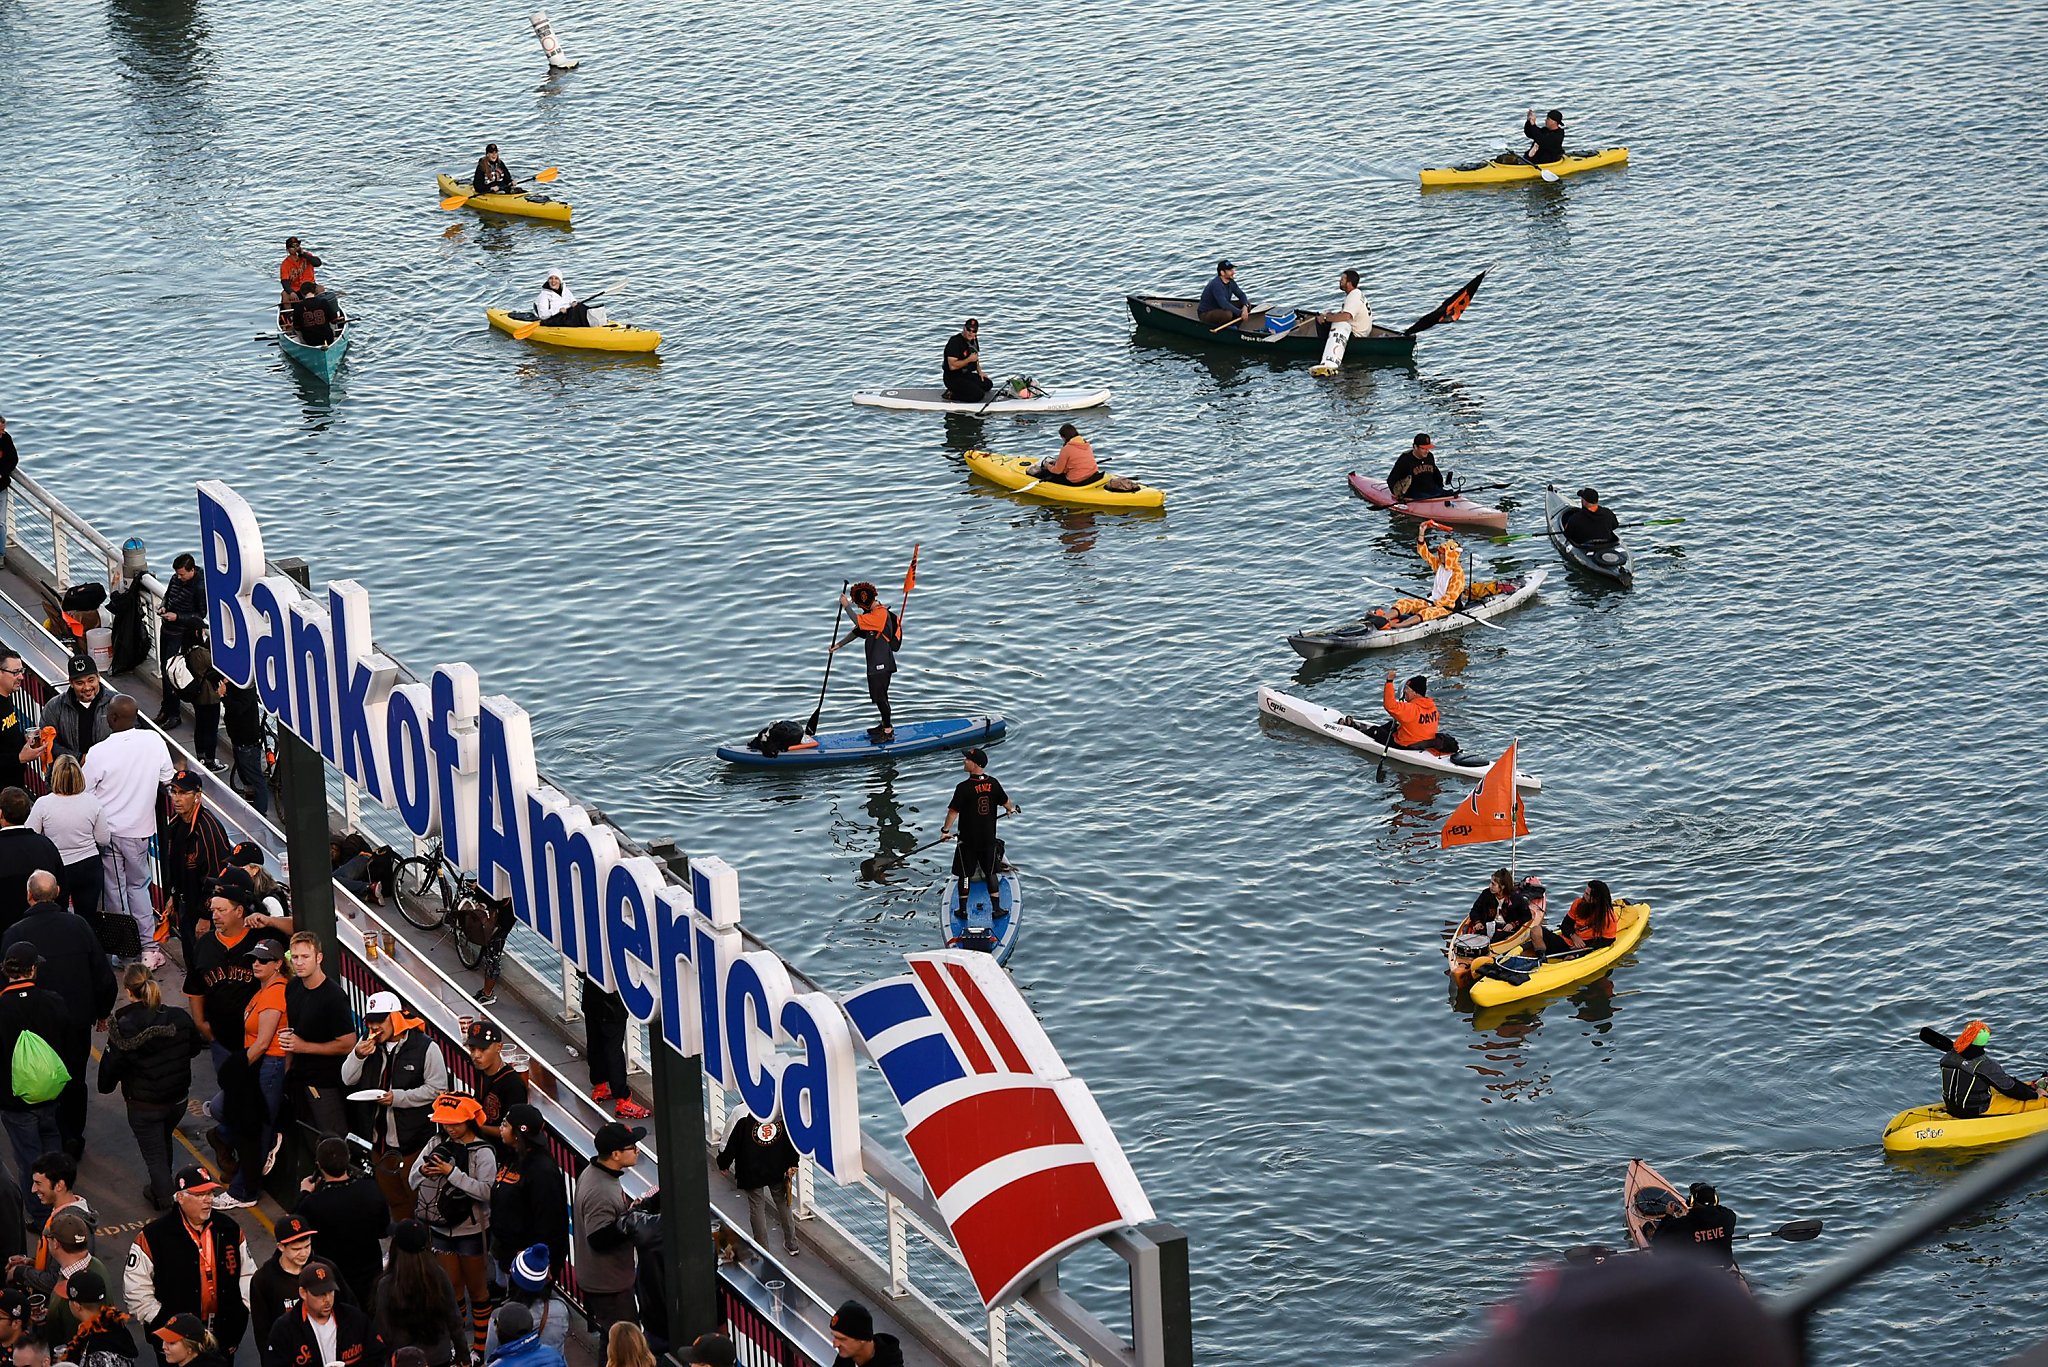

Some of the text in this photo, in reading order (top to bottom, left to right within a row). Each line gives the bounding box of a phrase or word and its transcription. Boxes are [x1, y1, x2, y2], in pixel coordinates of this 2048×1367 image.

[1270, 702, 1287, 714] epic
[197, 480, 863, 1184] Bank of America
[1694, 1226, 1725, 1243] STEVE
